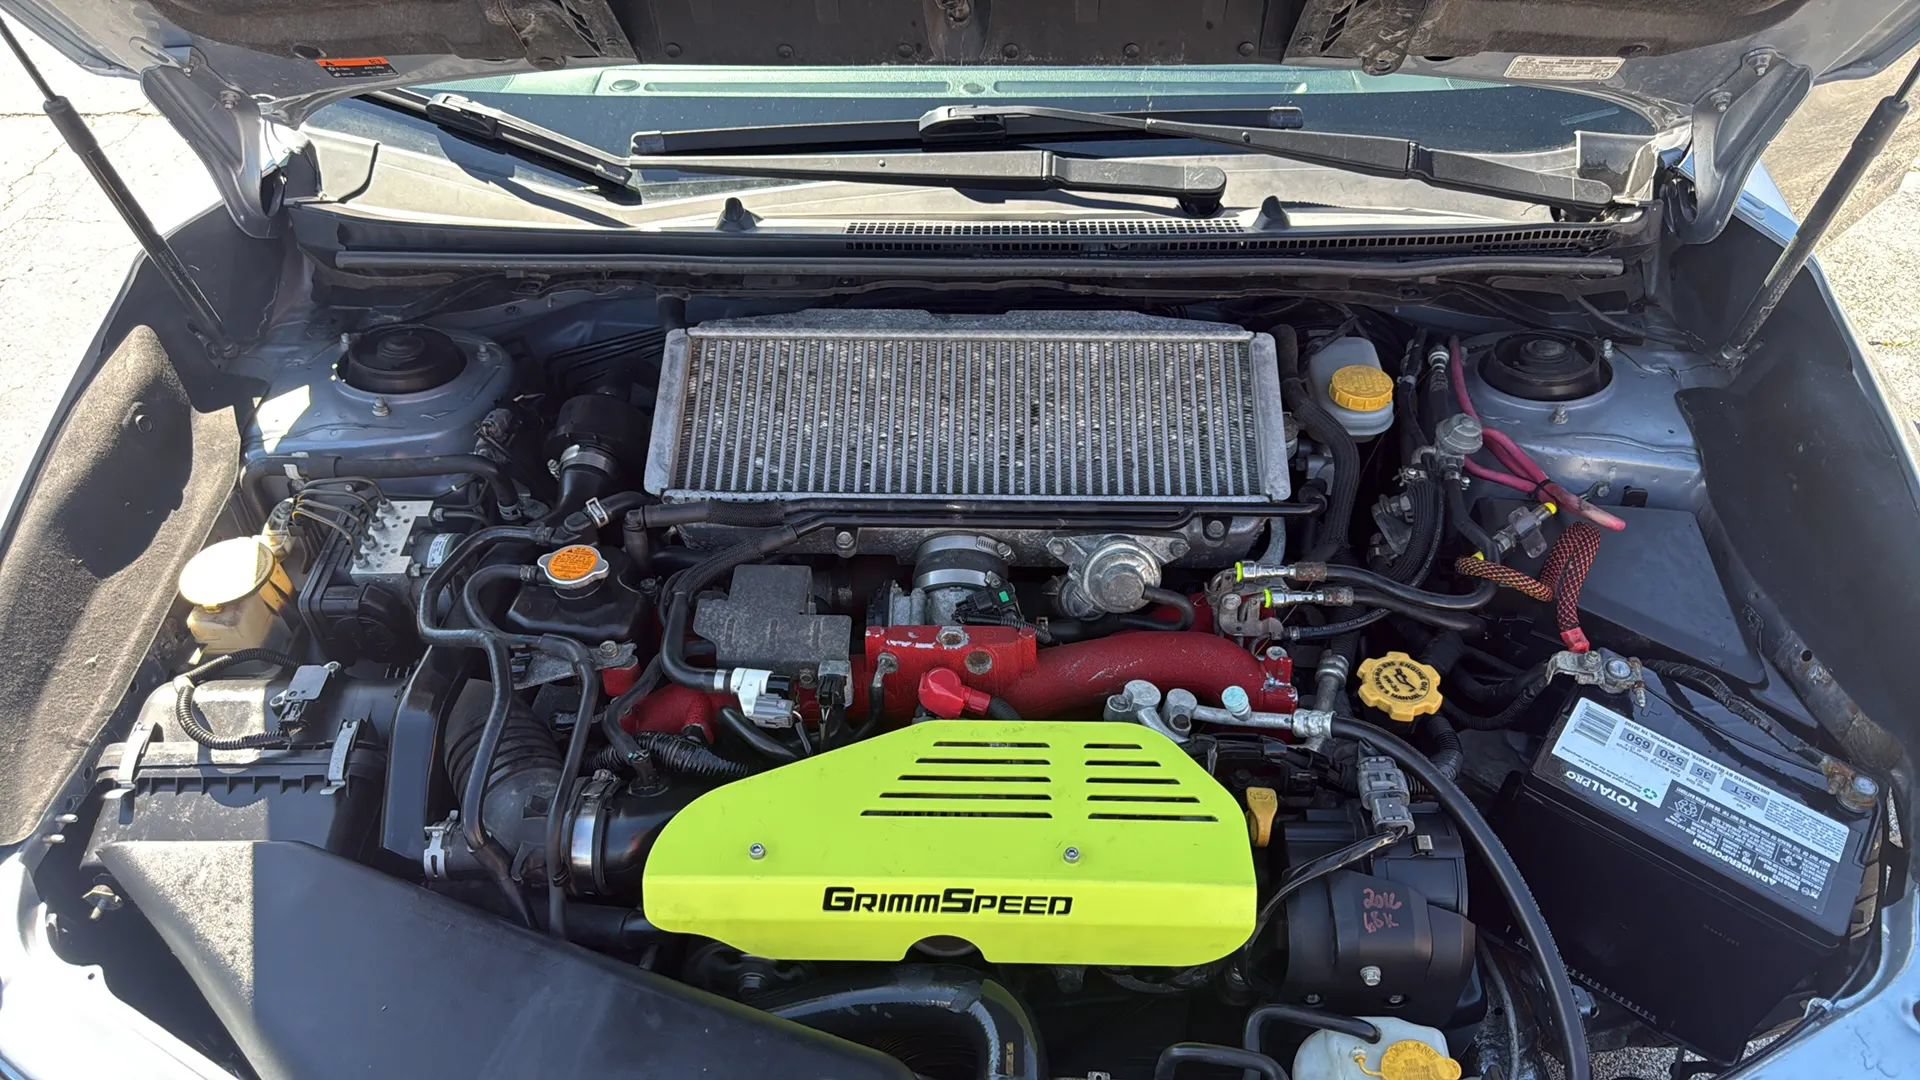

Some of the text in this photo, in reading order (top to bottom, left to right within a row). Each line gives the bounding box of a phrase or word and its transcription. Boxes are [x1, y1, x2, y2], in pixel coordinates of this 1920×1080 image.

[1399, 661, 1425, 680] ENGINE
[1626, 732, 1650, 749] 650
[1659, 749, 1684, 766] 520
[1697, 768, 1711, 780] 35
[1565, 770, 1638, 812] TOTALPRO
[1733, 786, 1760, 802] 35-T
[1692, 837, 1768, 882] DANGER/POISON
[1363, 888, 1402, 910] 2016
